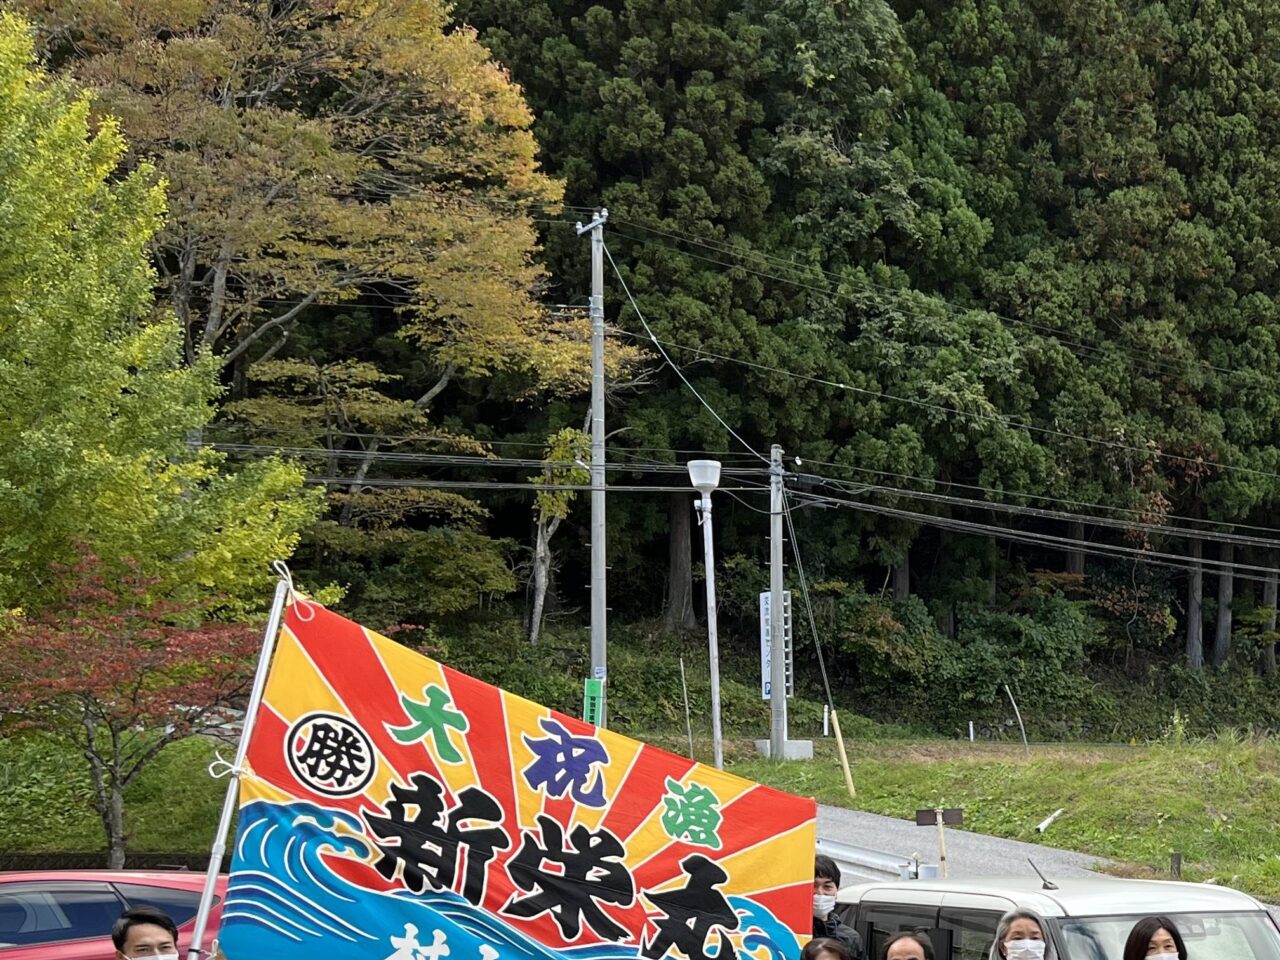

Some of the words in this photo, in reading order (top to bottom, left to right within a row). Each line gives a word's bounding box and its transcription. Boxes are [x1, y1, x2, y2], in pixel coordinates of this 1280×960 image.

[296, 722, 367, 788] 勝
[384, 684, 470, 763] 大
[521, 718, 610, 808] 祝
[661, 777, 723, 850] 漁
